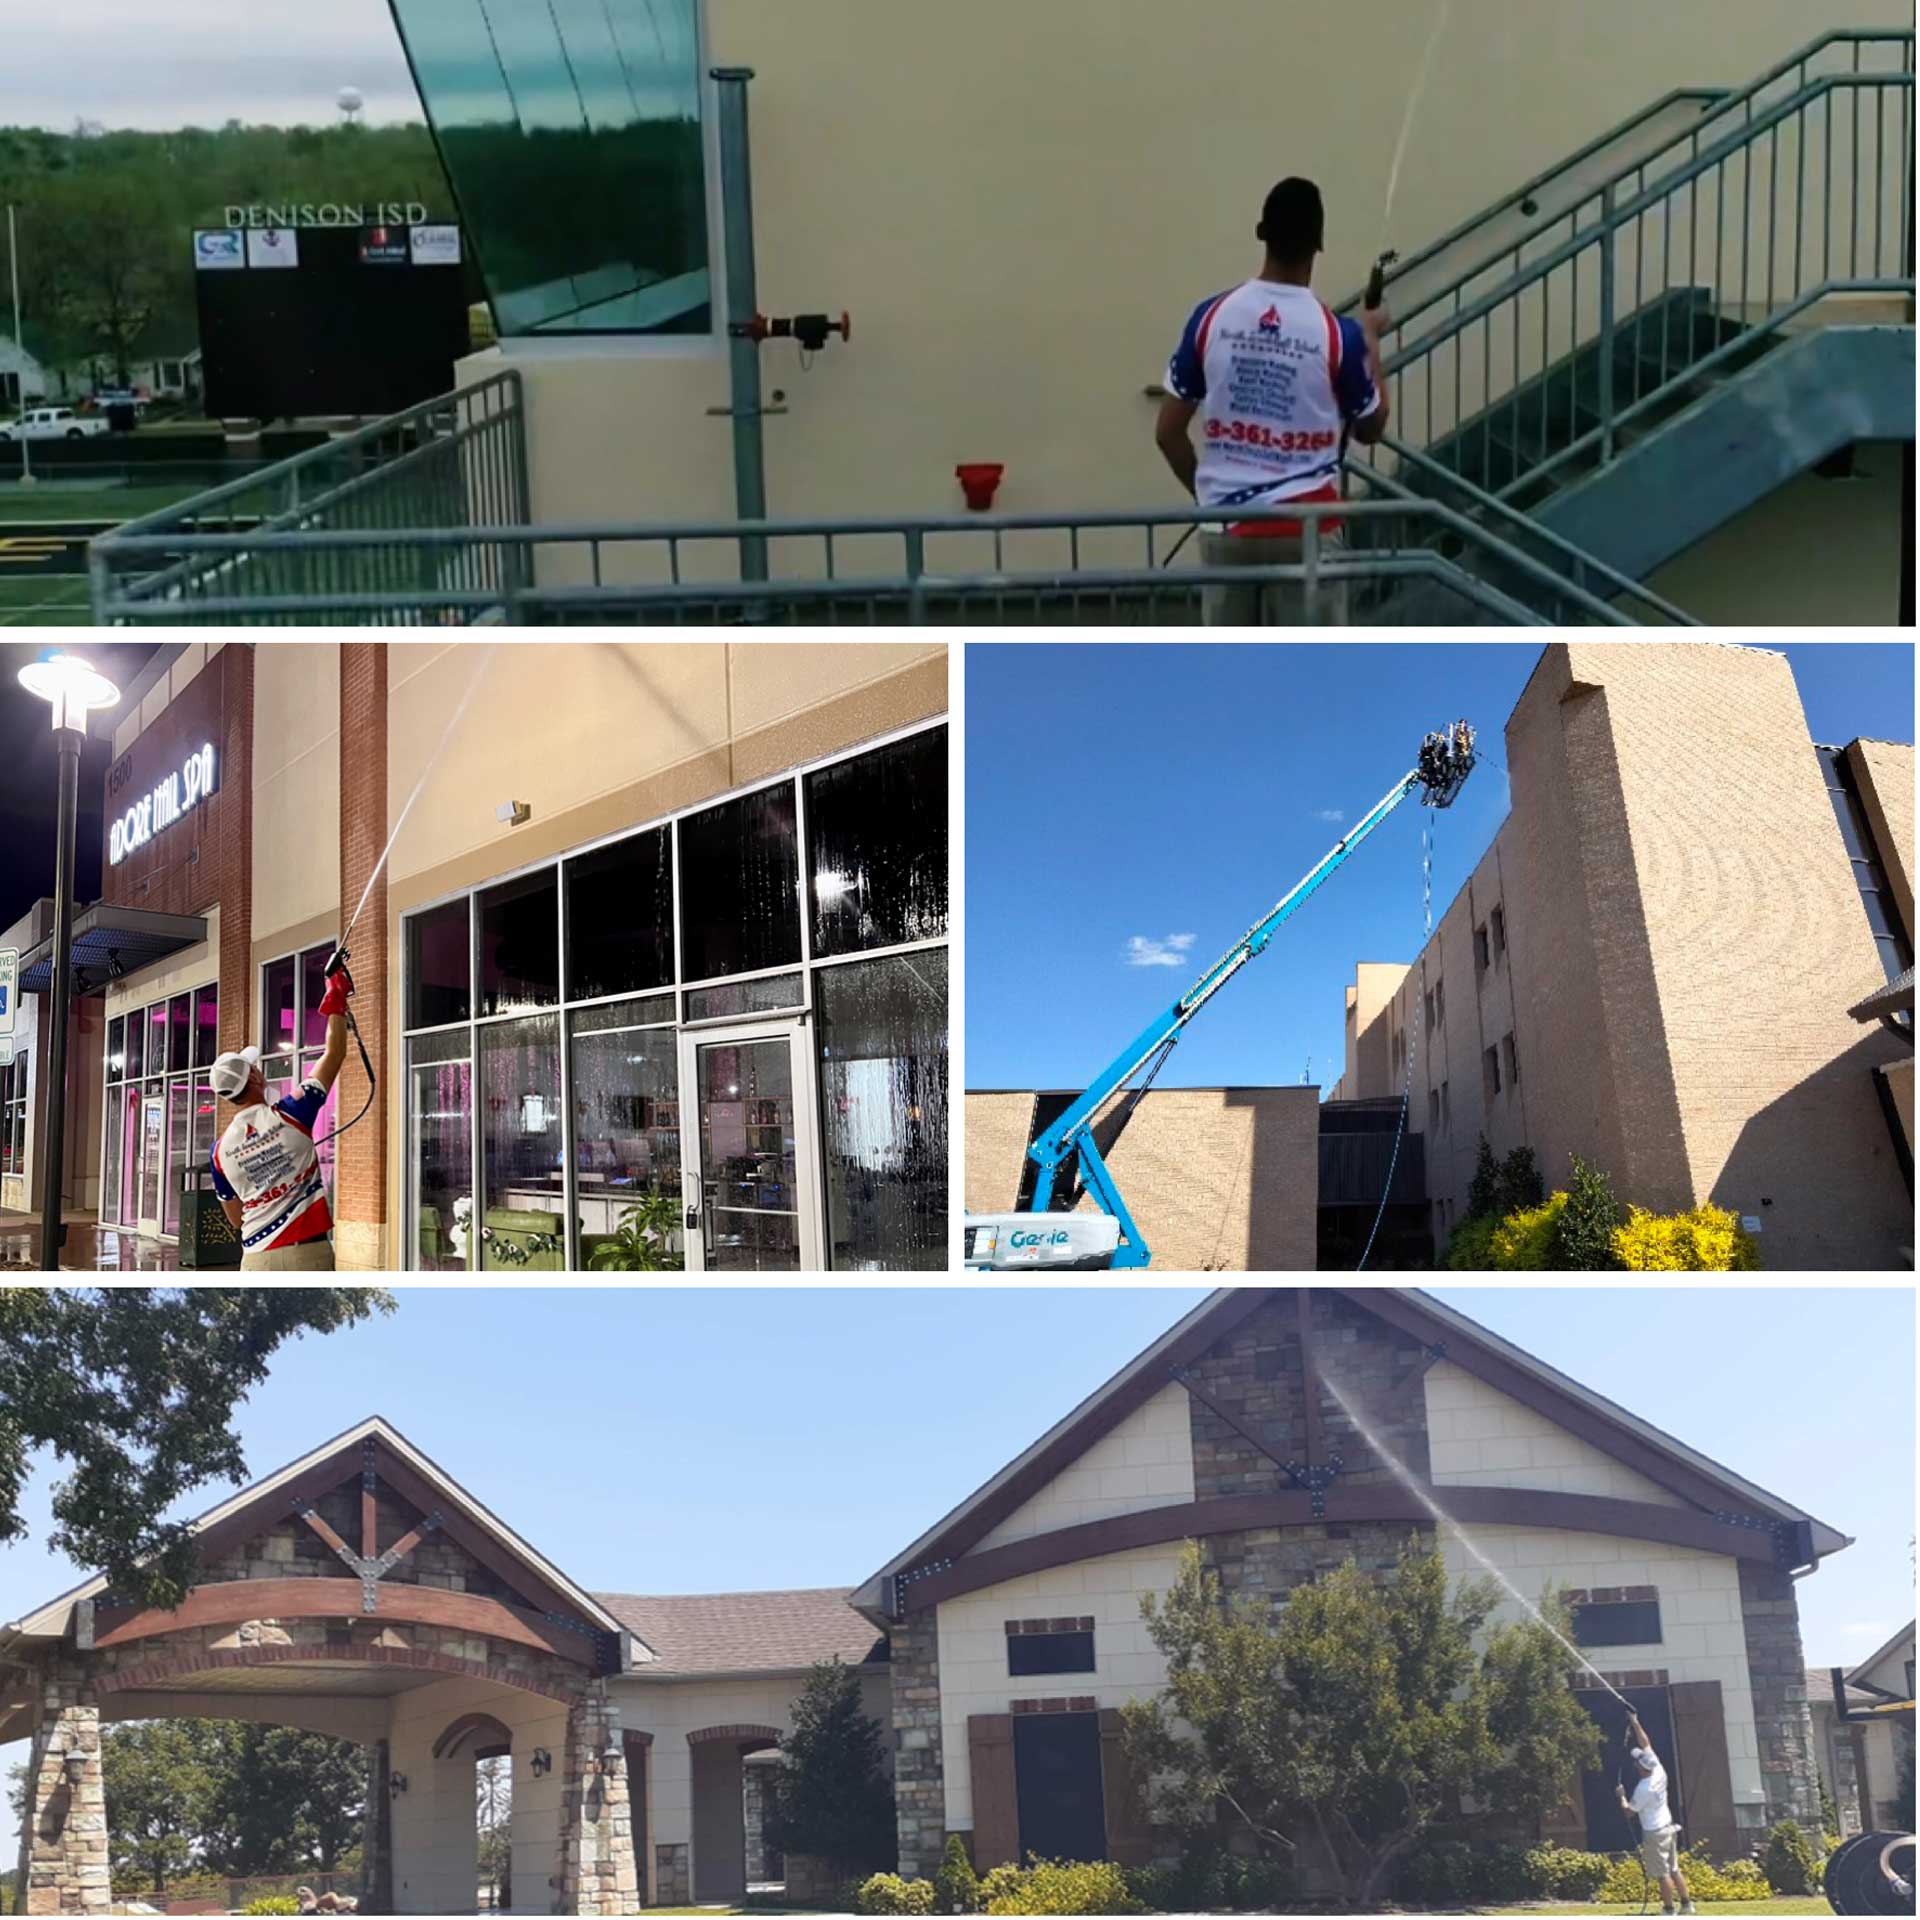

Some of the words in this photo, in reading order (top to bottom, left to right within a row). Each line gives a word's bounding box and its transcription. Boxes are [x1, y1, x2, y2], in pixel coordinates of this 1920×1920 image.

[225, 203, 363, 228] DENISON
[377, 202, 428, 226] ISD
[109, 793, 152, 867] ADORE
[152, 771, 181, 834] NAIL
[182, 742, 214, 811] SPA
